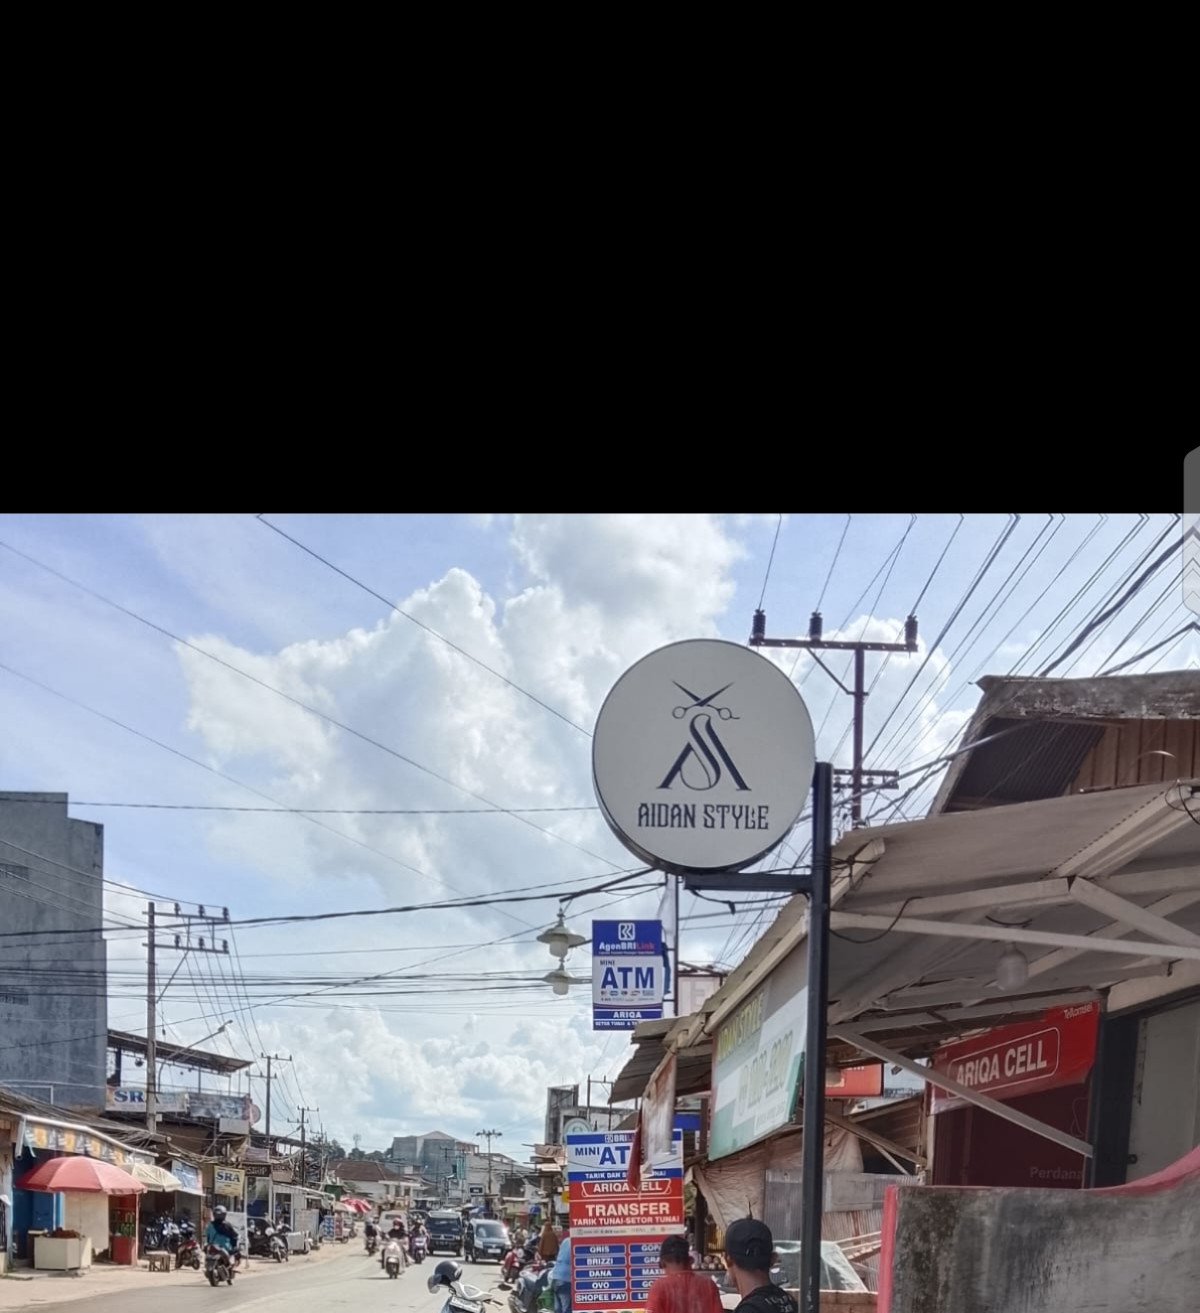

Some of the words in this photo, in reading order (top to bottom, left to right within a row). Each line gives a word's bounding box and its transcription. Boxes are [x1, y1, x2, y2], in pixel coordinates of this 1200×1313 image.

[637, 803, 696, 829] AIDAN
[703, 804, 769, 830] STYLE
[601, 967, 655, 989] ATM
[956, 1054, 1000, 1087] ARIQA
[1004, 1040, 1048, 1078] CELL
[575, 1147, 600, 1156] MINI
[599, 1145, 630, 1166] AT
[216, 1171, 240, 1183] SRA
[593, 1182, 630, 1193] ARIQA
[641, 1181, 663, 1191] ELL
[585, 1202, 670, 1217] TRANSFER
[575, 1294, 608, 1302] SHOPEE
